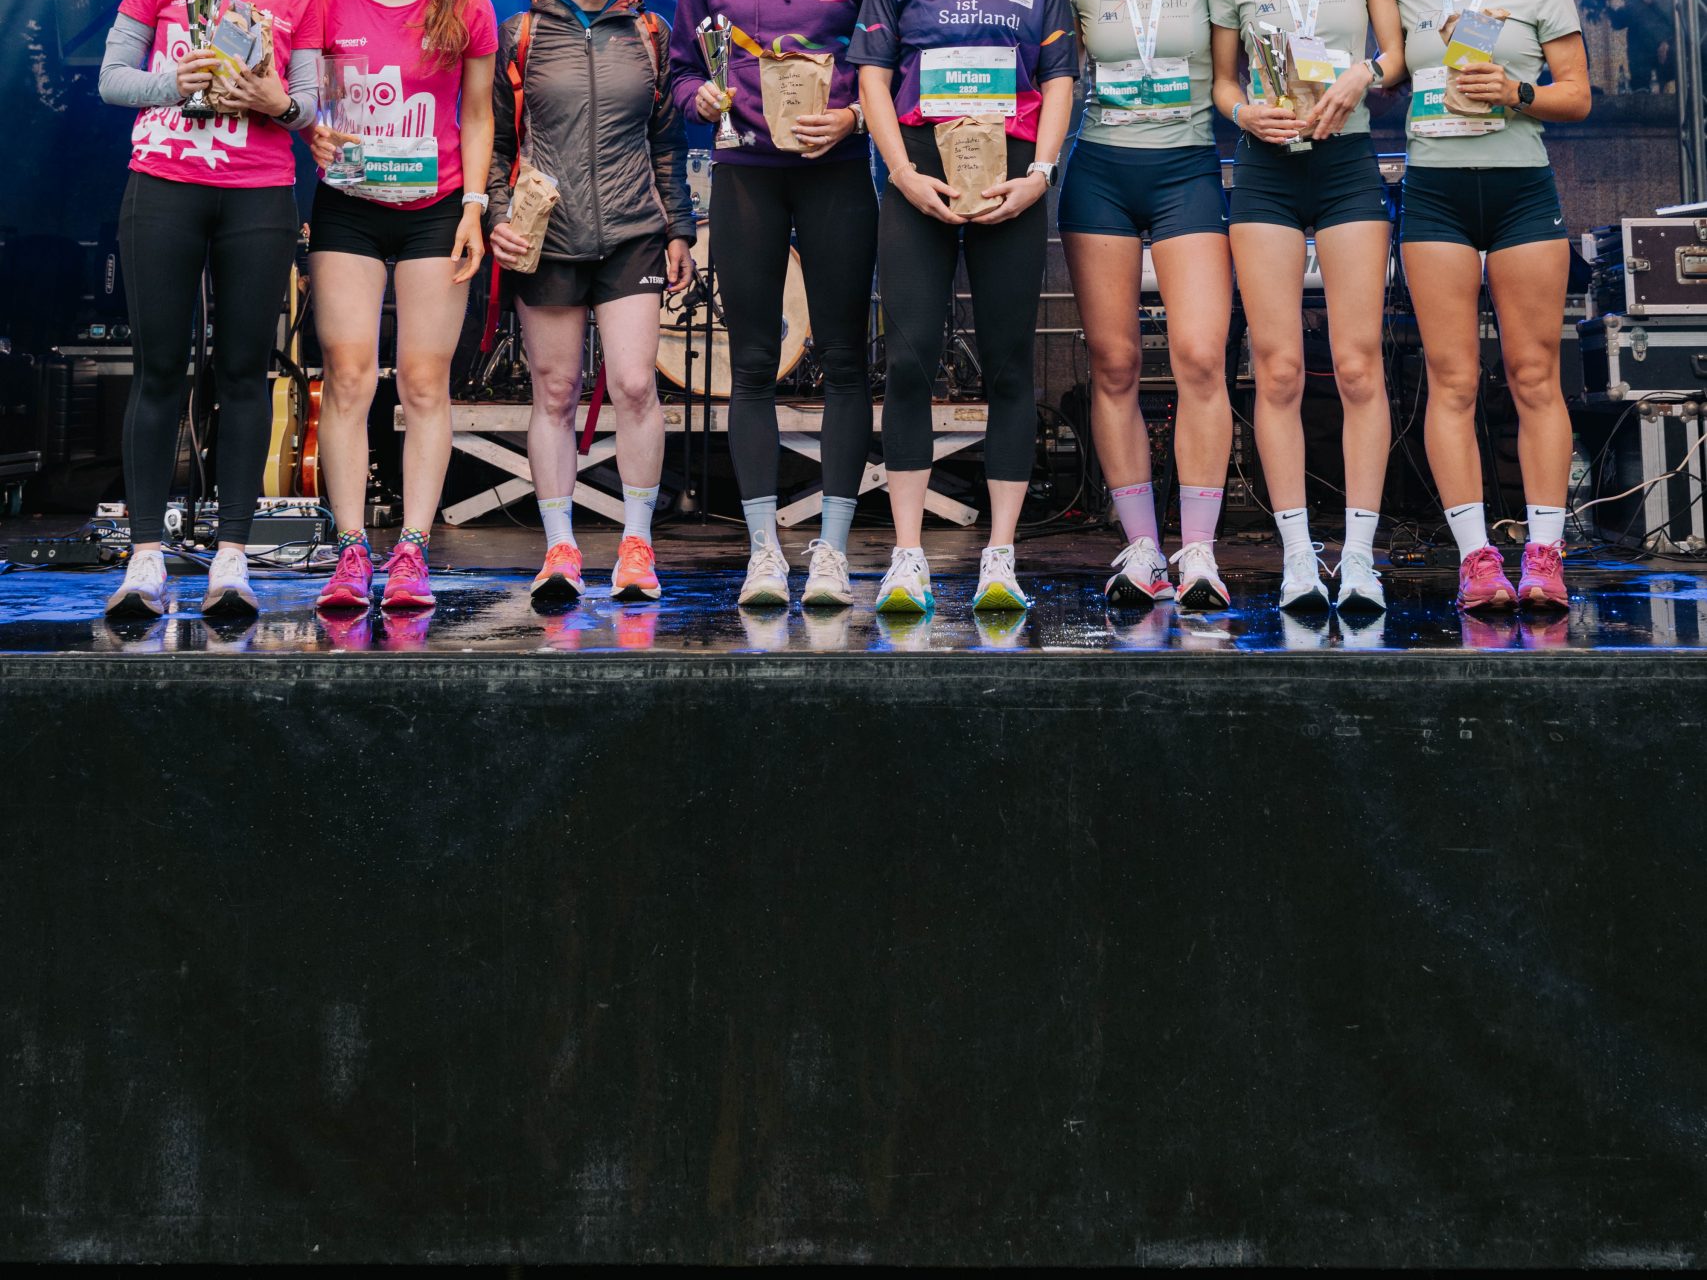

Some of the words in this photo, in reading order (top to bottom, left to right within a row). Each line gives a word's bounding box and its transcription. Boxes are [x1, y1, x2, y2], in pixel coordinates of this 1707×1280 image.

[938, 10, 1020, 30] Saarland!
[945, 71, 991, 84] Miriam
[959, 85, 978, 94] 2828
[1099, 85, 1139, 95] Johanna
[1142, 81, 1189, 94] tharina
[363, 160, 423, 172] onstanze
[383, 174, 397, 182] 144
